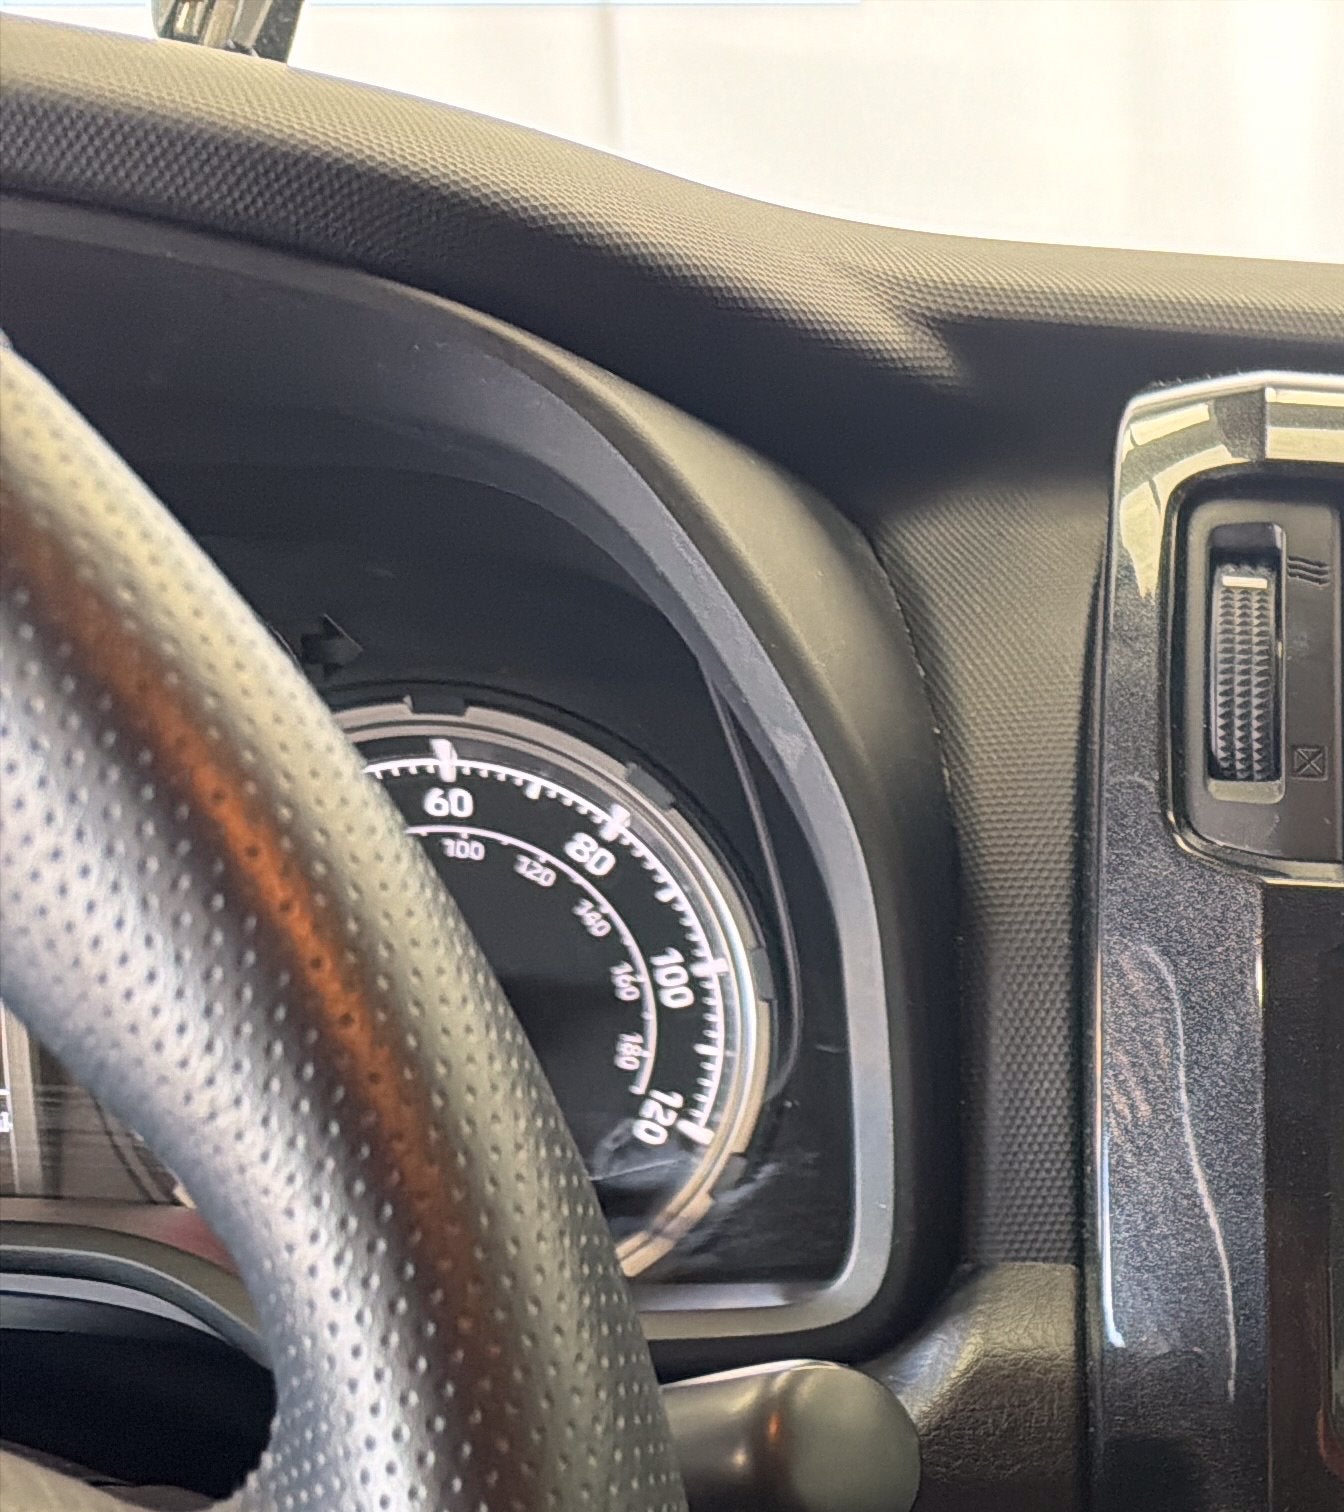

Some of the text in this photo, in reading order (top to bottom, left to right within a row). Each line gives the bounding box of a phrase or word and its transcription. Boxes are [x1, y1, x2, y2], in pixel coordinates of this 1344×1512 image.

[424, 788, 473, 817] 60
[443, 839, 485, 861] 100
[564, 831, 616, 876] 80
[650, 946, 694, 1008] 100
[632, 1089, 683, 1145] 120
